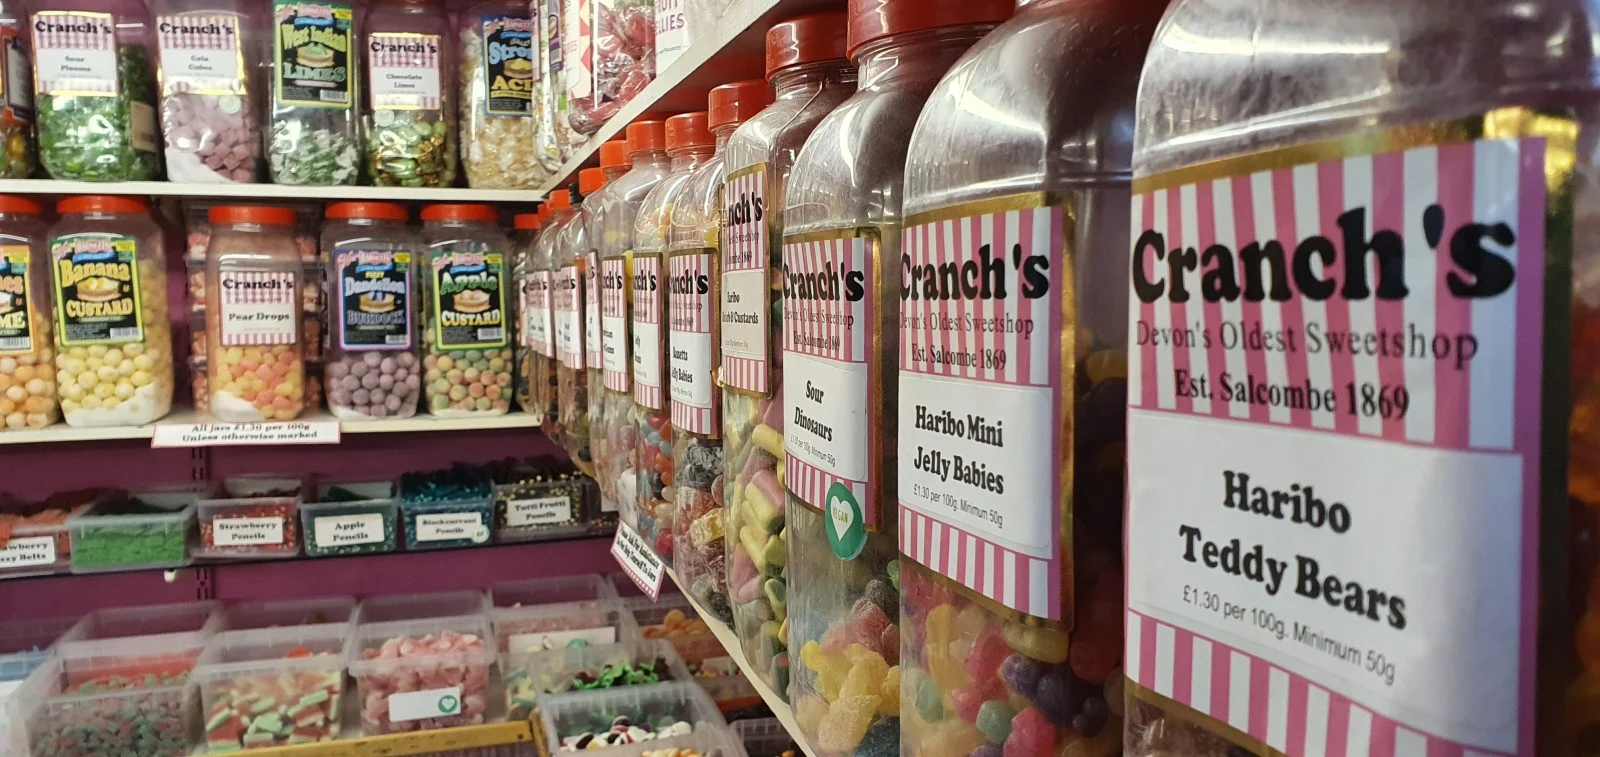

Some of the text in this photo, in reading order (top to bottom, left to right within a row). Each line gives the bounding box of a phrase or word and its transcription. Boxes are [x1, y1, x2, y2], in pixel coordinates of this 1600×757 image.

[35, 20, 112, 34] Cranch's
[160, 22, 234, 35] Cranch's
[281, 24, 309, 50] West
[371, 42, 438, 54] Cranch's
[283, 61, 346, 82] LIMES
[1132, 204, 1516, 302] Cranch's
[59, 259, 130, 288] Banana
[222, 279, 294, 289] Cranch's
[440, 272, 498, 296] Apple
[782, 260, 864, 302] Cranch's
[900, 244, 1050, 300] Cranch's
[345, 277, 405, 296] Dandelion
[66, 298, 133, 318] CUSTARD
[228, 312, 290, 321] Pear Drops
[442, 310, 501, 327] CUSTARD
[930, 312, 962, 332] Oldest
[965, 312, 1034, 340] Sweetshop
[912, 343, 1007, 370] Est. Salcombe 1869
[1136, 320, 1478, 371] Devon's Oldest Sweetshop
[679, 367, 693, 384] Babies
[806, 380, 824, 404] Sour
[1175, 368, 1410, 420] Est. Salcombe 1869
[192, 424, 207, 432] All
[210, 424, 230, 433] jars
[794, 406, 832, 442] Dinosaurs
[915, 404, 1003, 447] Haribo Mini
[182, 431, 318, 442] Unless otherwise marked
[914, 446, 1004, 495] Jelly Babies
[914, 483, 930, 500] £1.30
[930, 493, 940, 506] per
[960, 499, 988, 520] Minimum
[989, 509, 1003, 528] 50g
[1222, 470, 1352, 534] Haribo
[219, 522, 276, 531] Strawberry
[333, 534, 369, 542] Pencils
[335, 522, 366, 530] Apple
[1179, 524, 1408, 631] Teddy Bears
[1183, 585, 1396, 686] £1.30 per 100g. Minimum 50g
